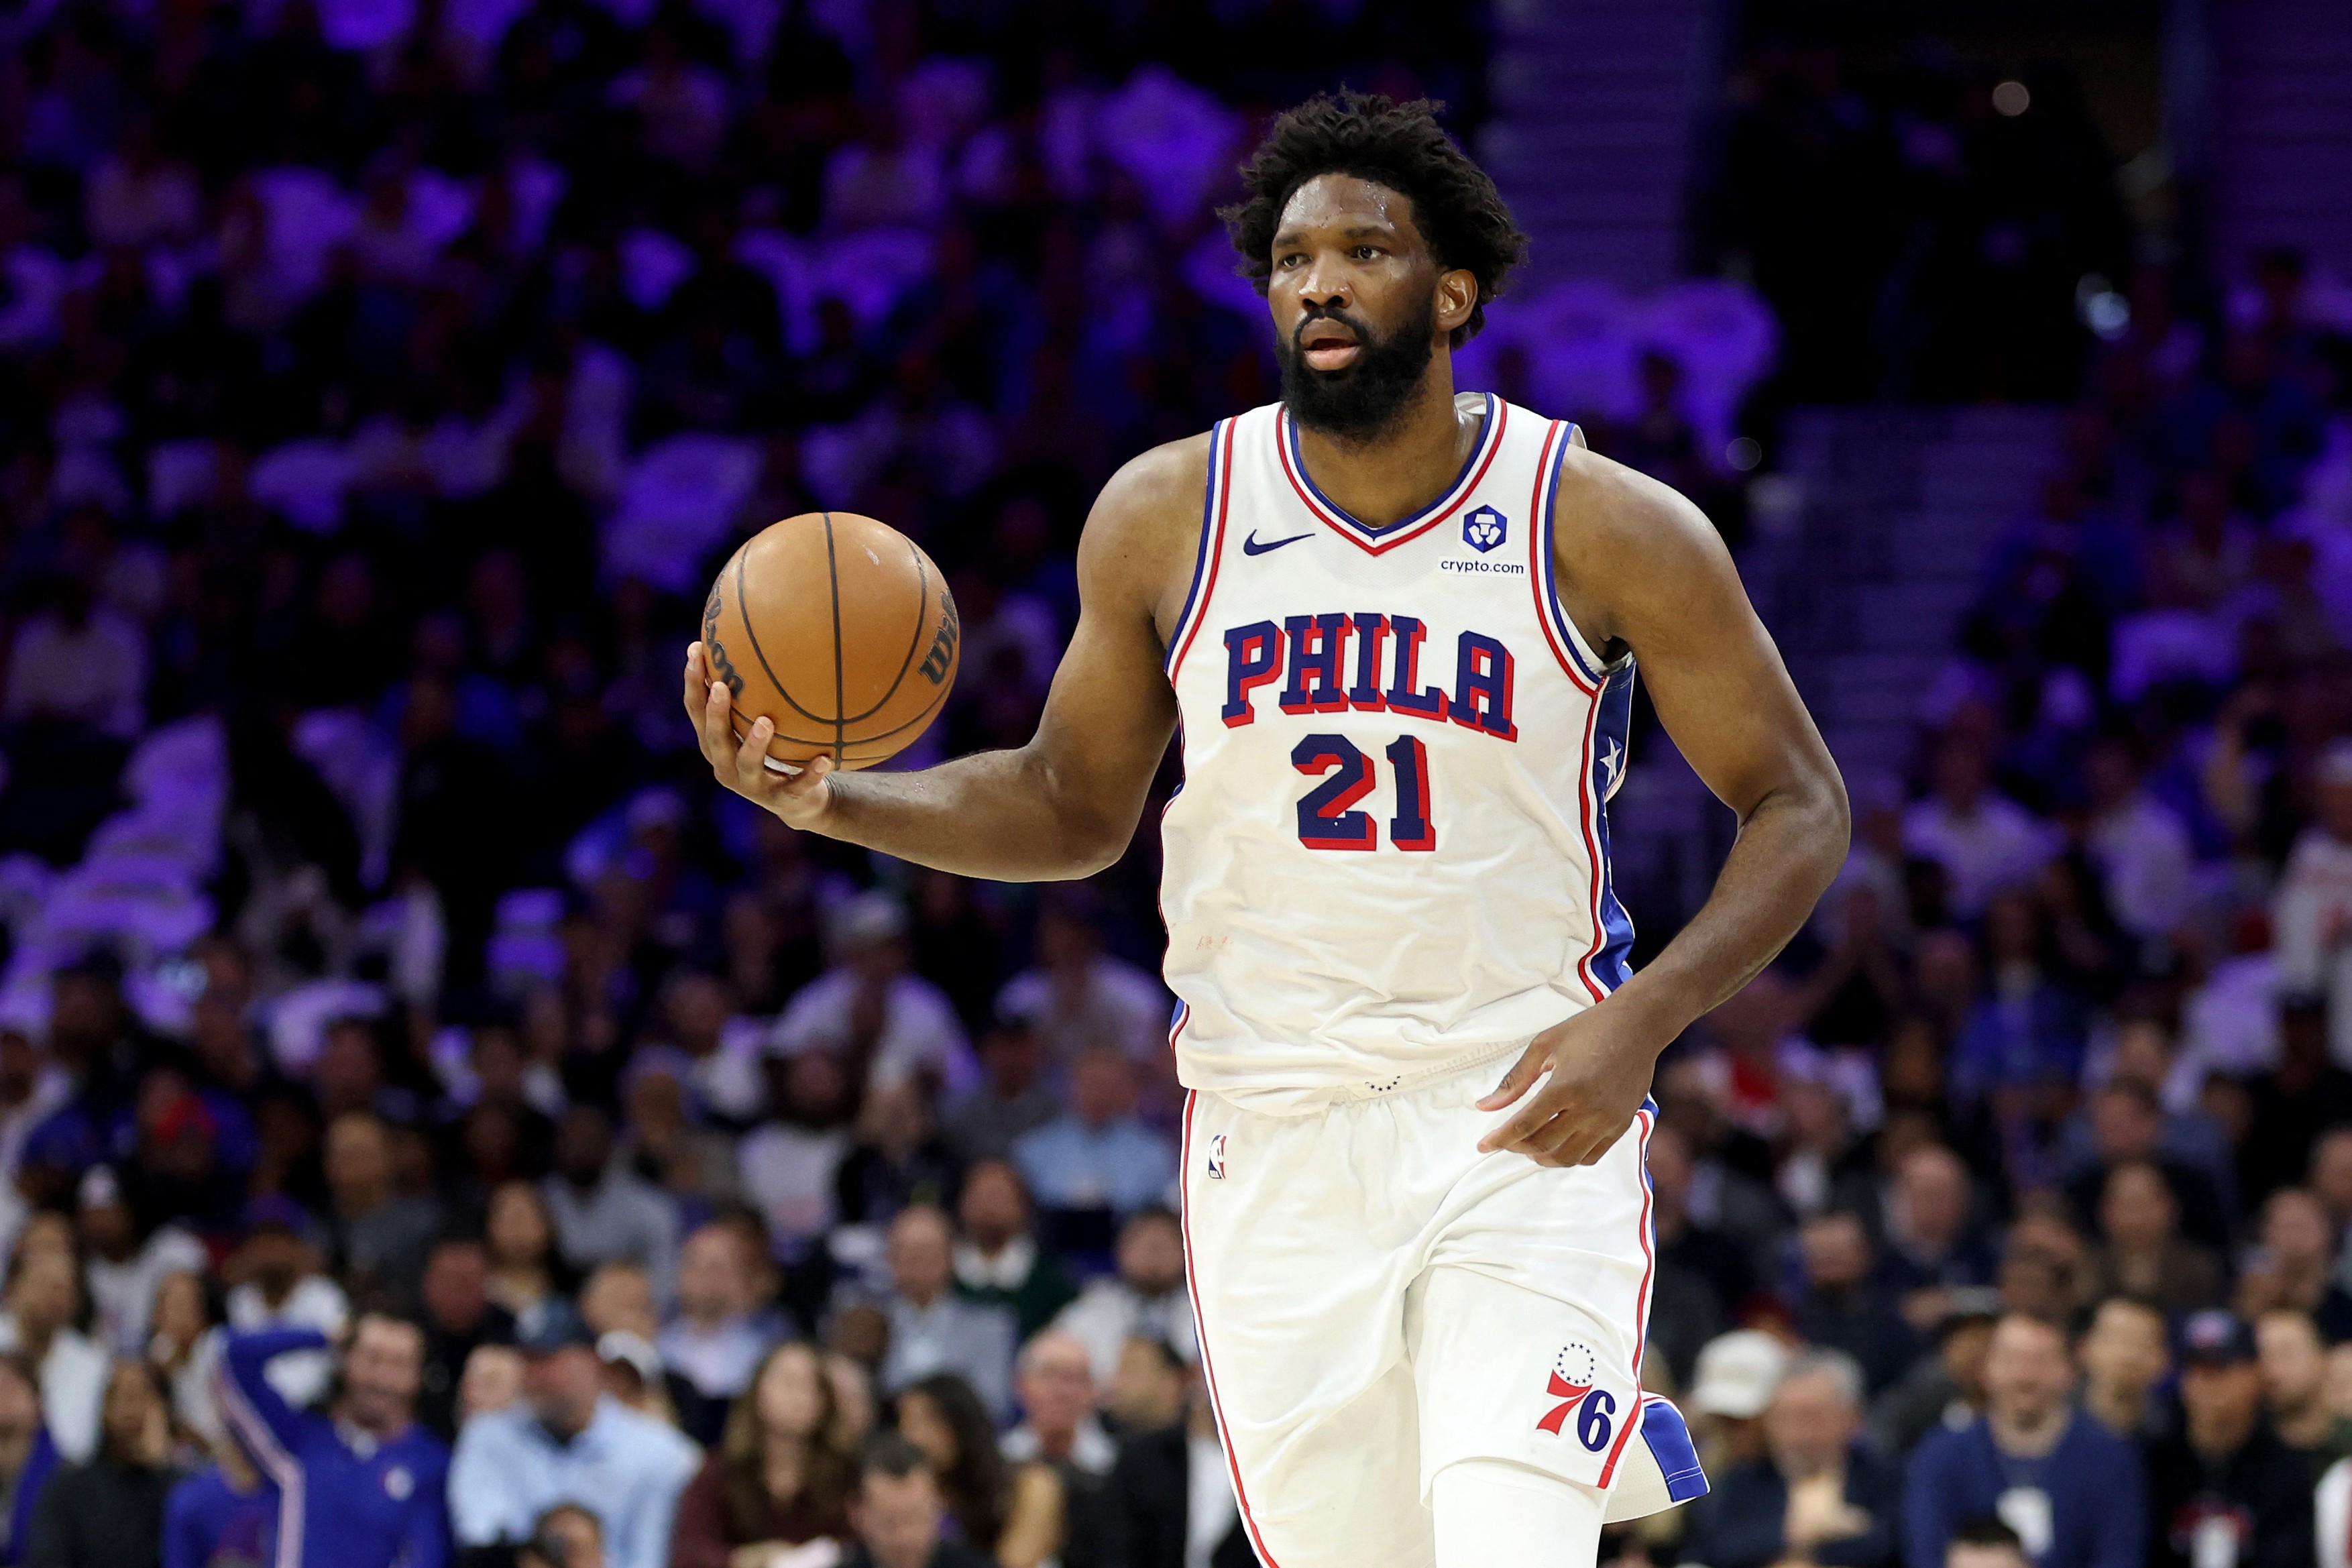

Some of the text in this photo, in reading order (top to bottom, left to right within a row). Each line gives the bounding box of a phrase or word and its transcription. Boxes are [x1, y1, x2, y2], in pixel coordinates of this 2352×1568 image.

[1441, 560, 1524, 574] crypto.com
[1221, 612, 1518, 743] PHILA
[1290, 734, 1436, 852] 21
[1536, 1368, 1616, 1453] 76
